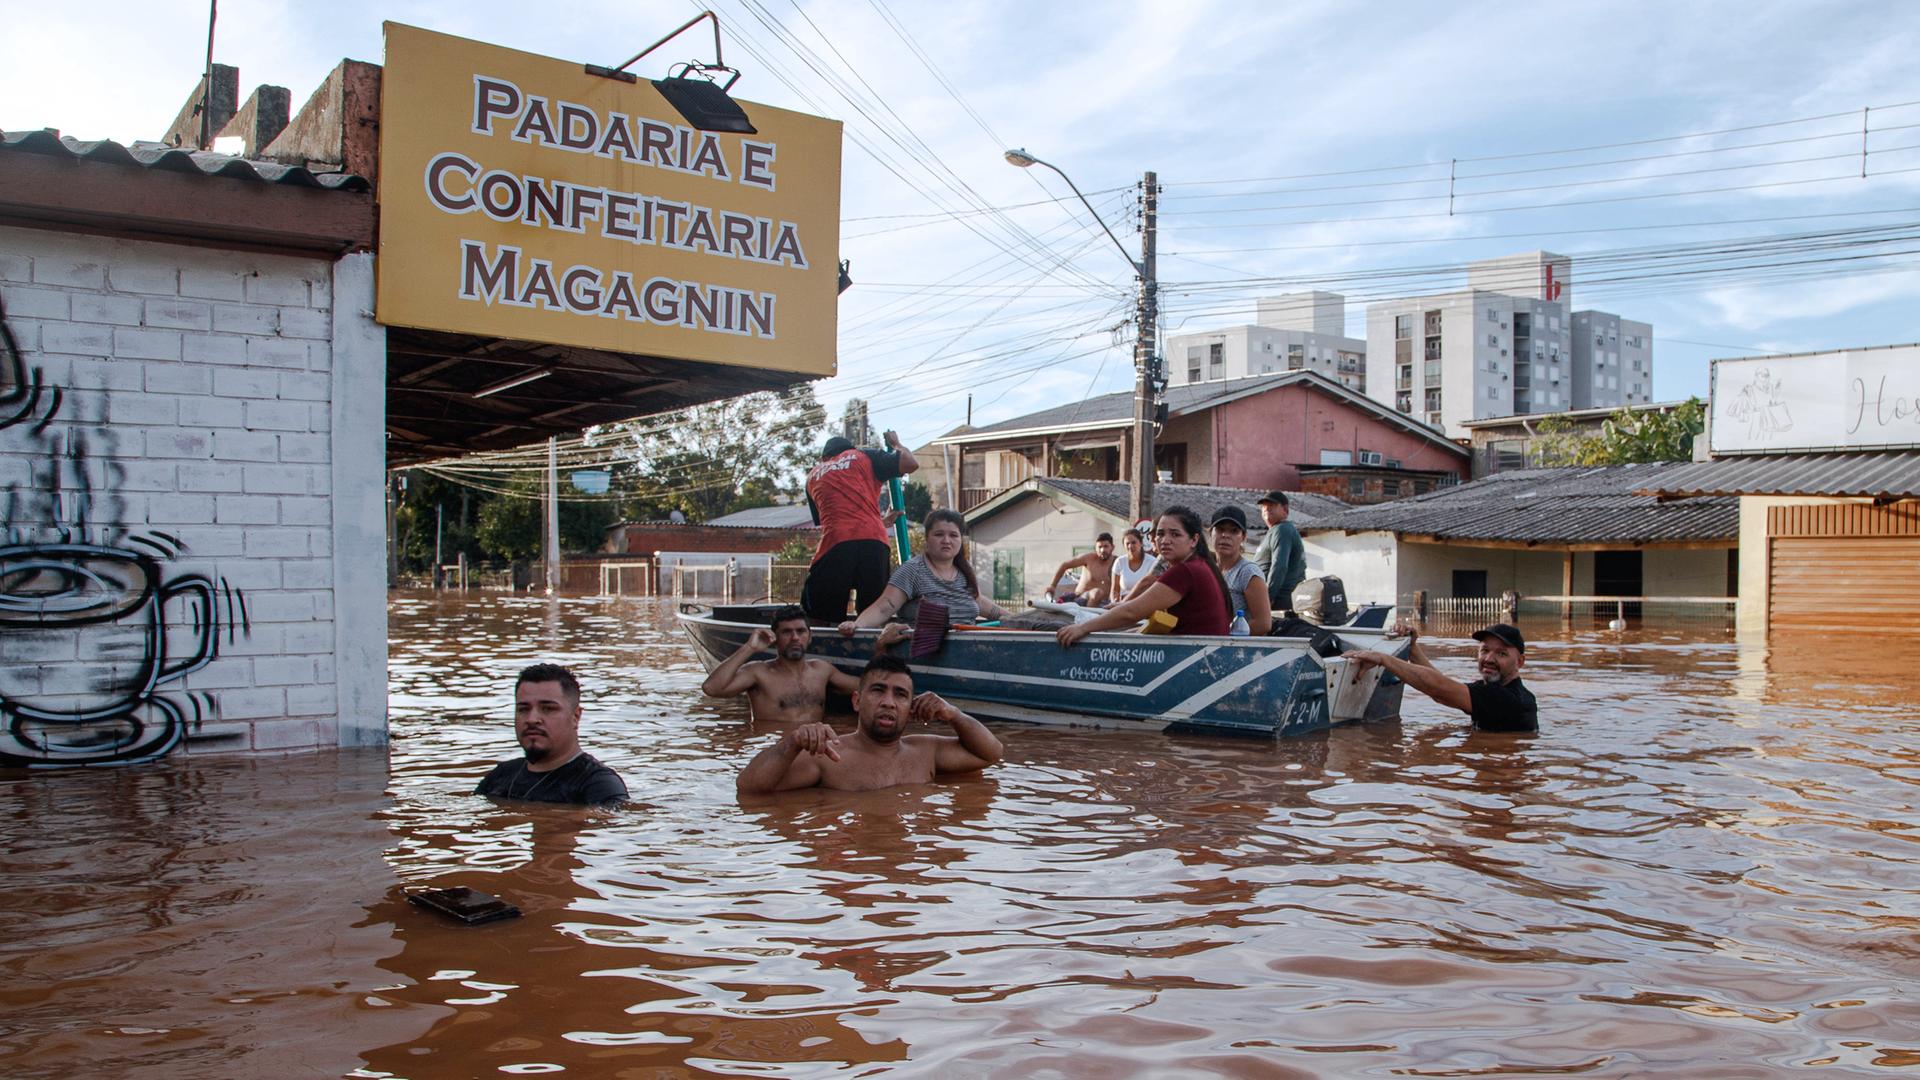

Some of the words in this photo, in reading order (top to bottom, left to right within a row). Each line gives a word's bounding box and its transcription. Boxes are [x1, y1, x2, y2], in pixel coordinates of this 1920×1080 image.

[471, 74, 732, 182] PADARIA
[739, 139, 777, 192] E
[425, 152, 808, 270] CONFEITARIA
[458, 239, 776, 339] MAGAGNIN
[1332, 594, 1343, 603] 15
